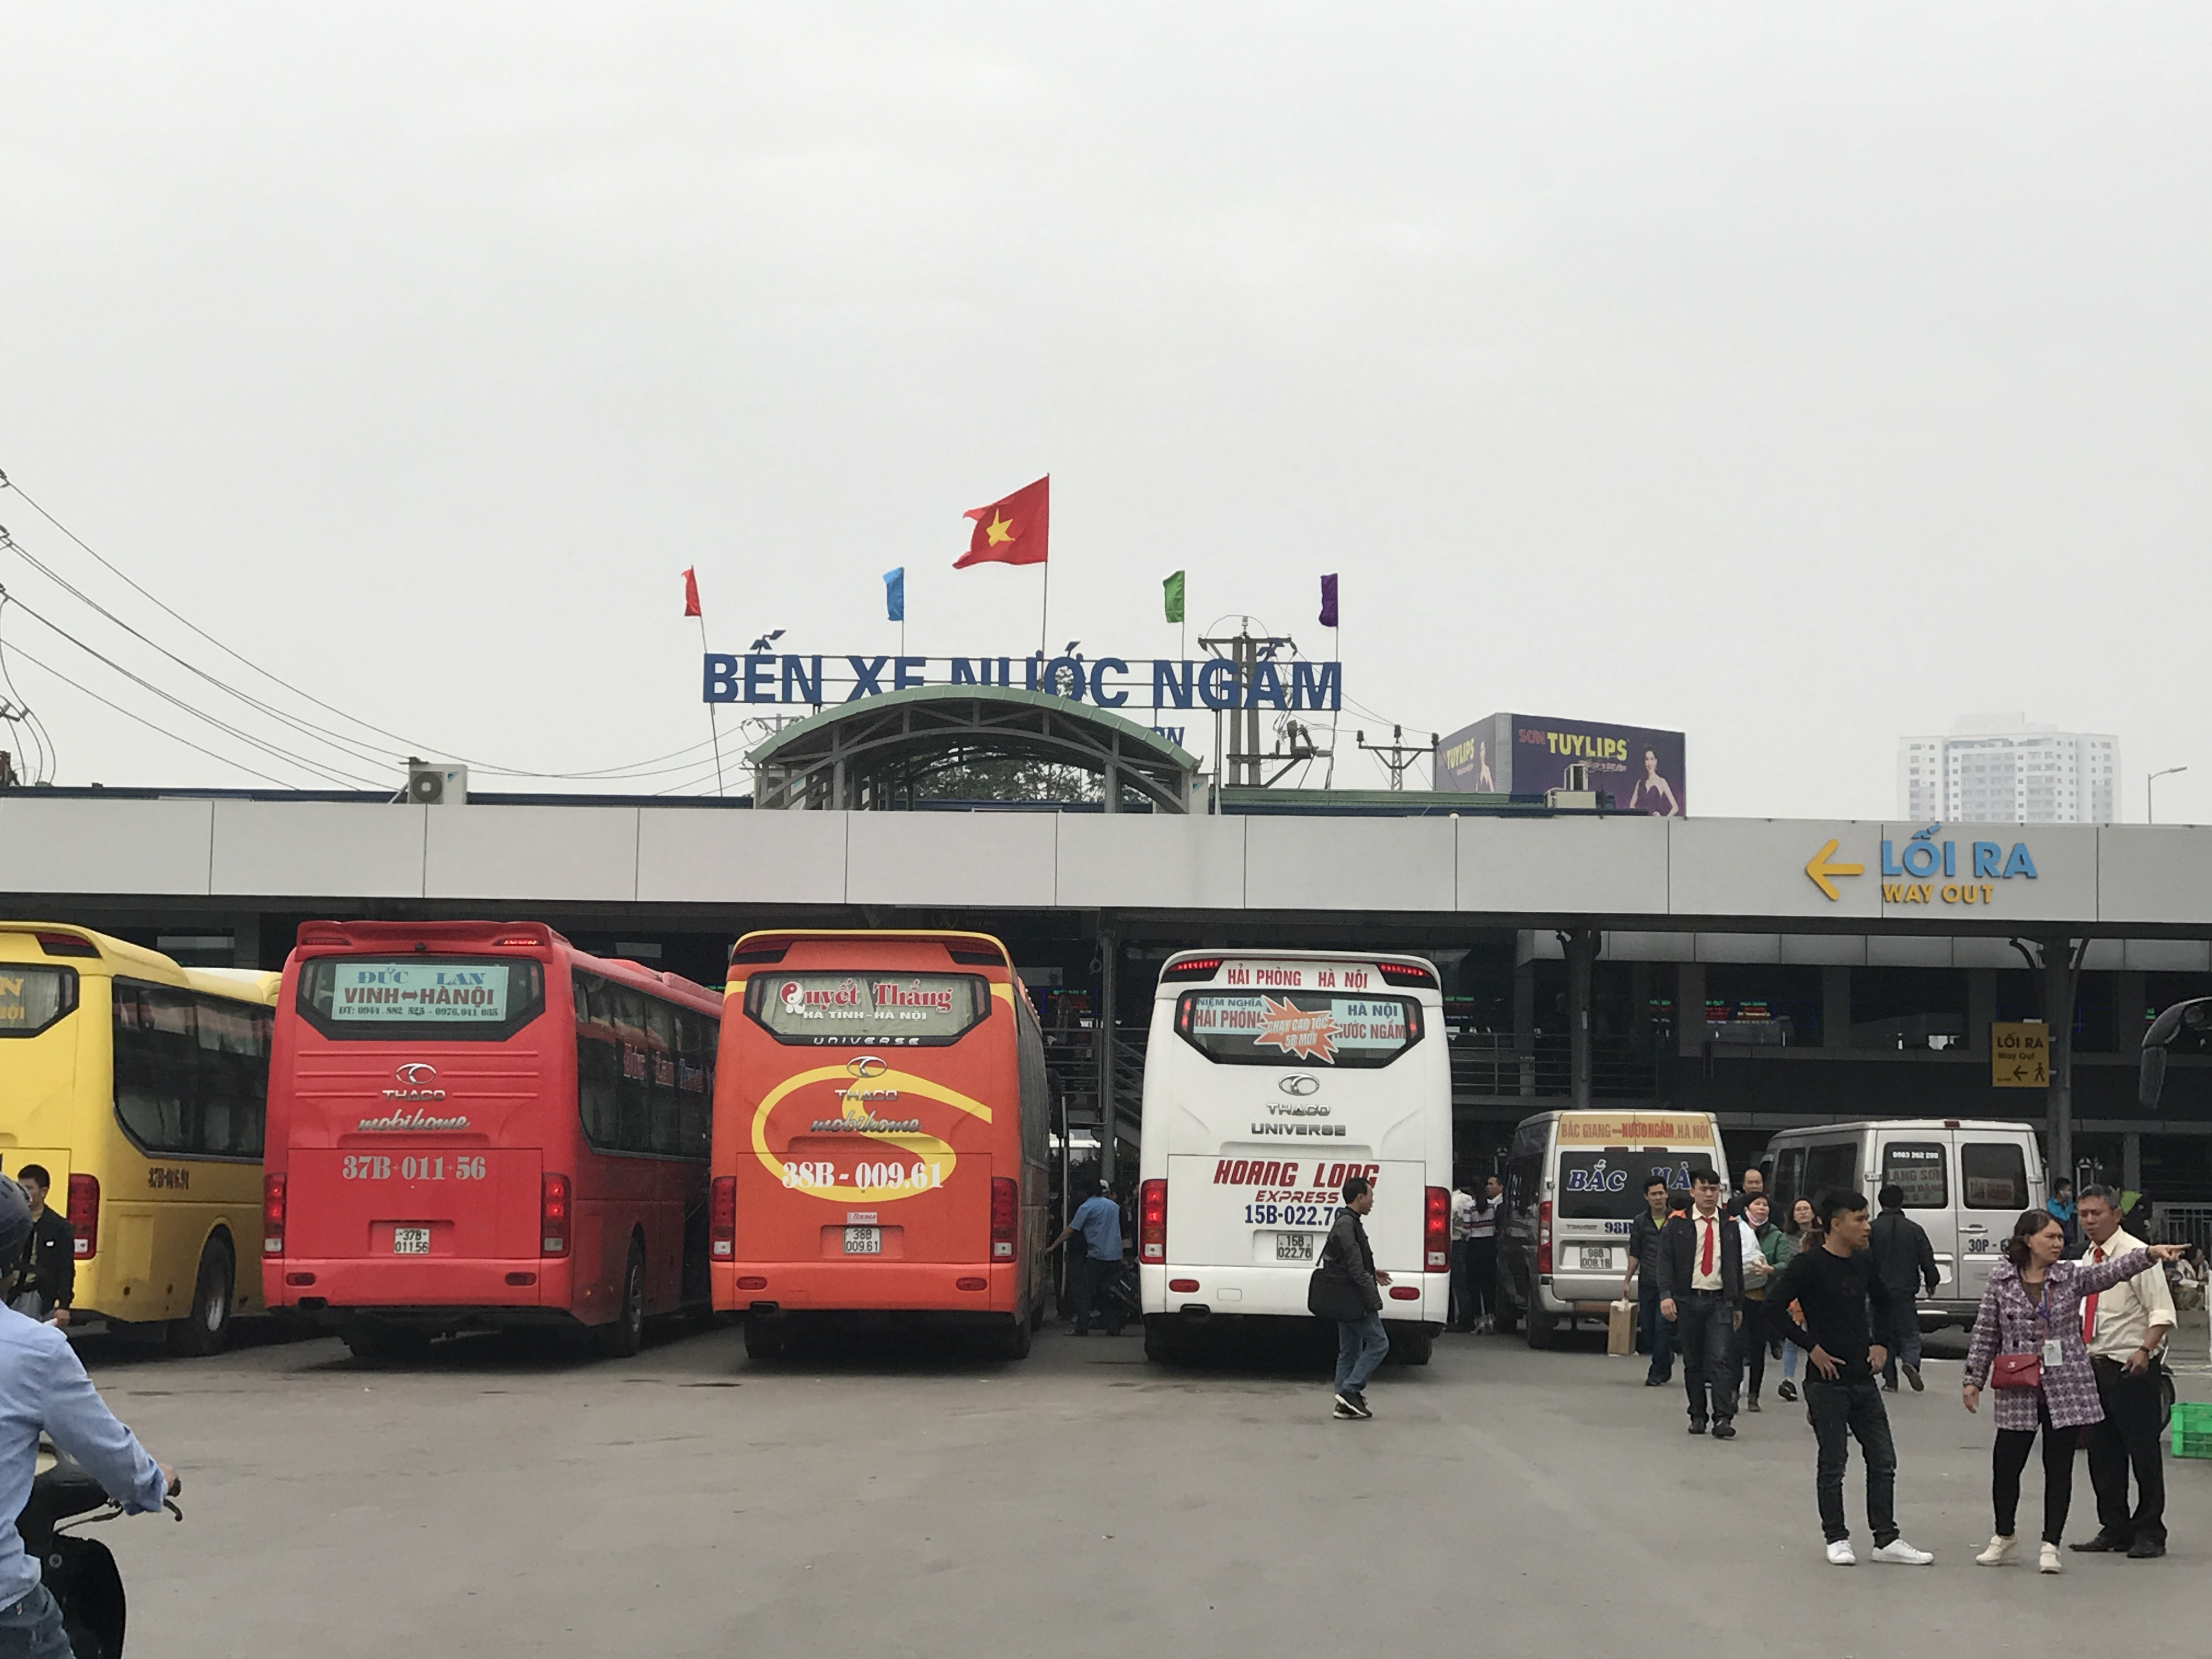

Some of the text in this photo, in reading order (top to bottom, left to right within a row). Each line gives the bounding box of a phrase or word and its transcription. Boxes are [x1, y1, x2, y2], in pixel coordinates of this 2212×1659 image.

[704, 629, 822, 703] BẾN
[843, 655, 926, 704] XE
[1446, 737, 1475, 770] TUYLIPS
[1547, 732, 1628, 761] TUYLIPS
[1882, 821, 2038, 878] LỐI RA
[1883, 883, 1994, 904] WAY OUT
[358, 967, 486, 986] ĐỨC LAN
[1227, 963, 1368, 992] HẢI PHÒNG HÀ NỘI
[345, 987, 399, 1004] VINH
[780, 978, 953, 1014] Quyết Thắng
[803, 1010, 824, 1019] HÀ
[874, 1011, 895, 1019] HÀ
[900, 1010, 927, 1022] NỘI
[1348, 1002, 1398, 1019] HÀ NỘI
[1997, 1032, 2044, 1048] LỐI RA
[382, 1089, 445, 1102] THACO
[834, 1089, 898, 1101] THACO
[1266, 1103, 1331, 1116] THACO
[358, 1108, 471, 1132] mobihome
[810, 1110, 923, 1133] mobihome
[1251, 1123, 1346, 1136] UNIVERSE
[1583, 1123, 1611, 1138] GIANG
[1213, 1160, 1299, 1187] HOANG
[1566, 1159, 1628, 1192] BẮC
[1255, 1190, 1340, 1204] EXPRESS
[403, 1229, 422, 1241] 37B
[854, 1228, 872, 1240] 38B
[1286, 1235, 1305, 1247] 15B
[1588, 1248, 1604, 1259] 98B
